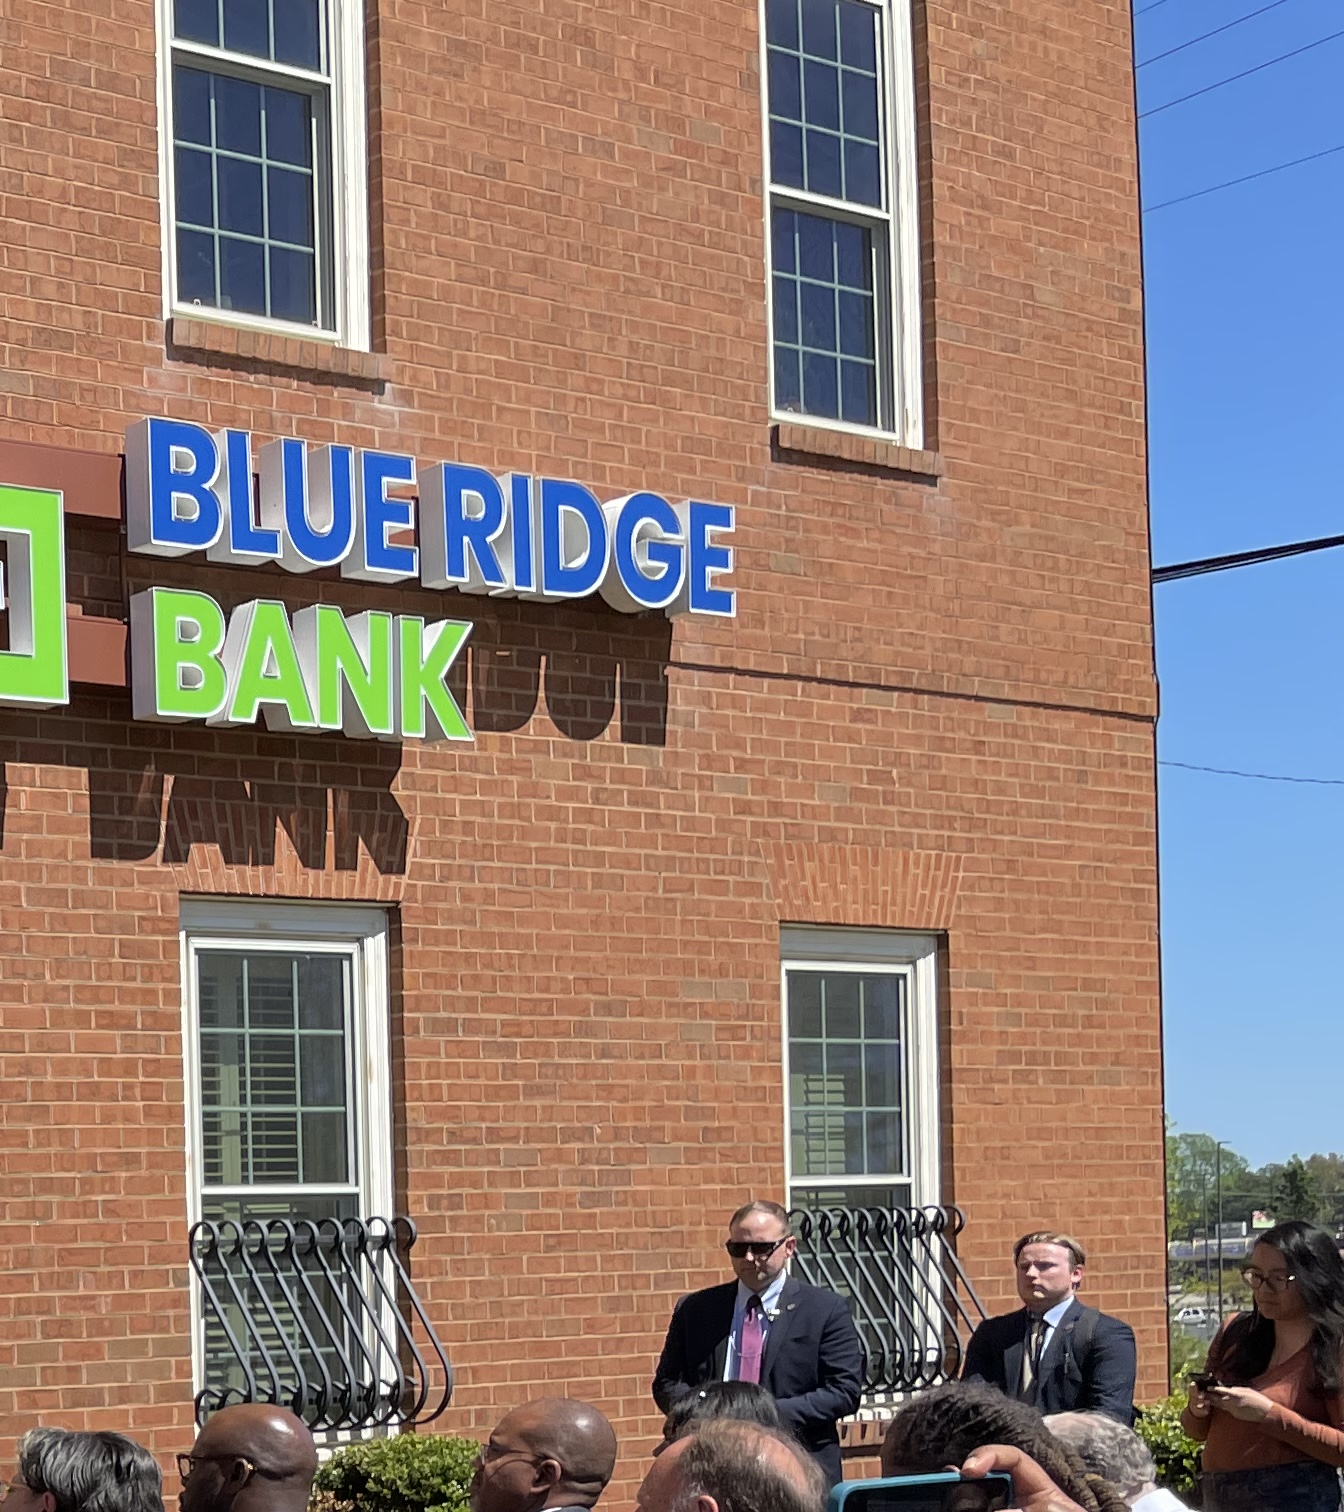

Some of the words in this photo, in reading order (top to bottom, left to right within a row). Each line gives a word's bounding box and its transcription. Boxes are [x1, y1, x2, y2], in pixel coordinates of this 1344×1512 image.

[144, 416, 419, 577] BLUE
[441, 460, 736, 618] RIDGE
[150, 587, 474, 742] BANK
